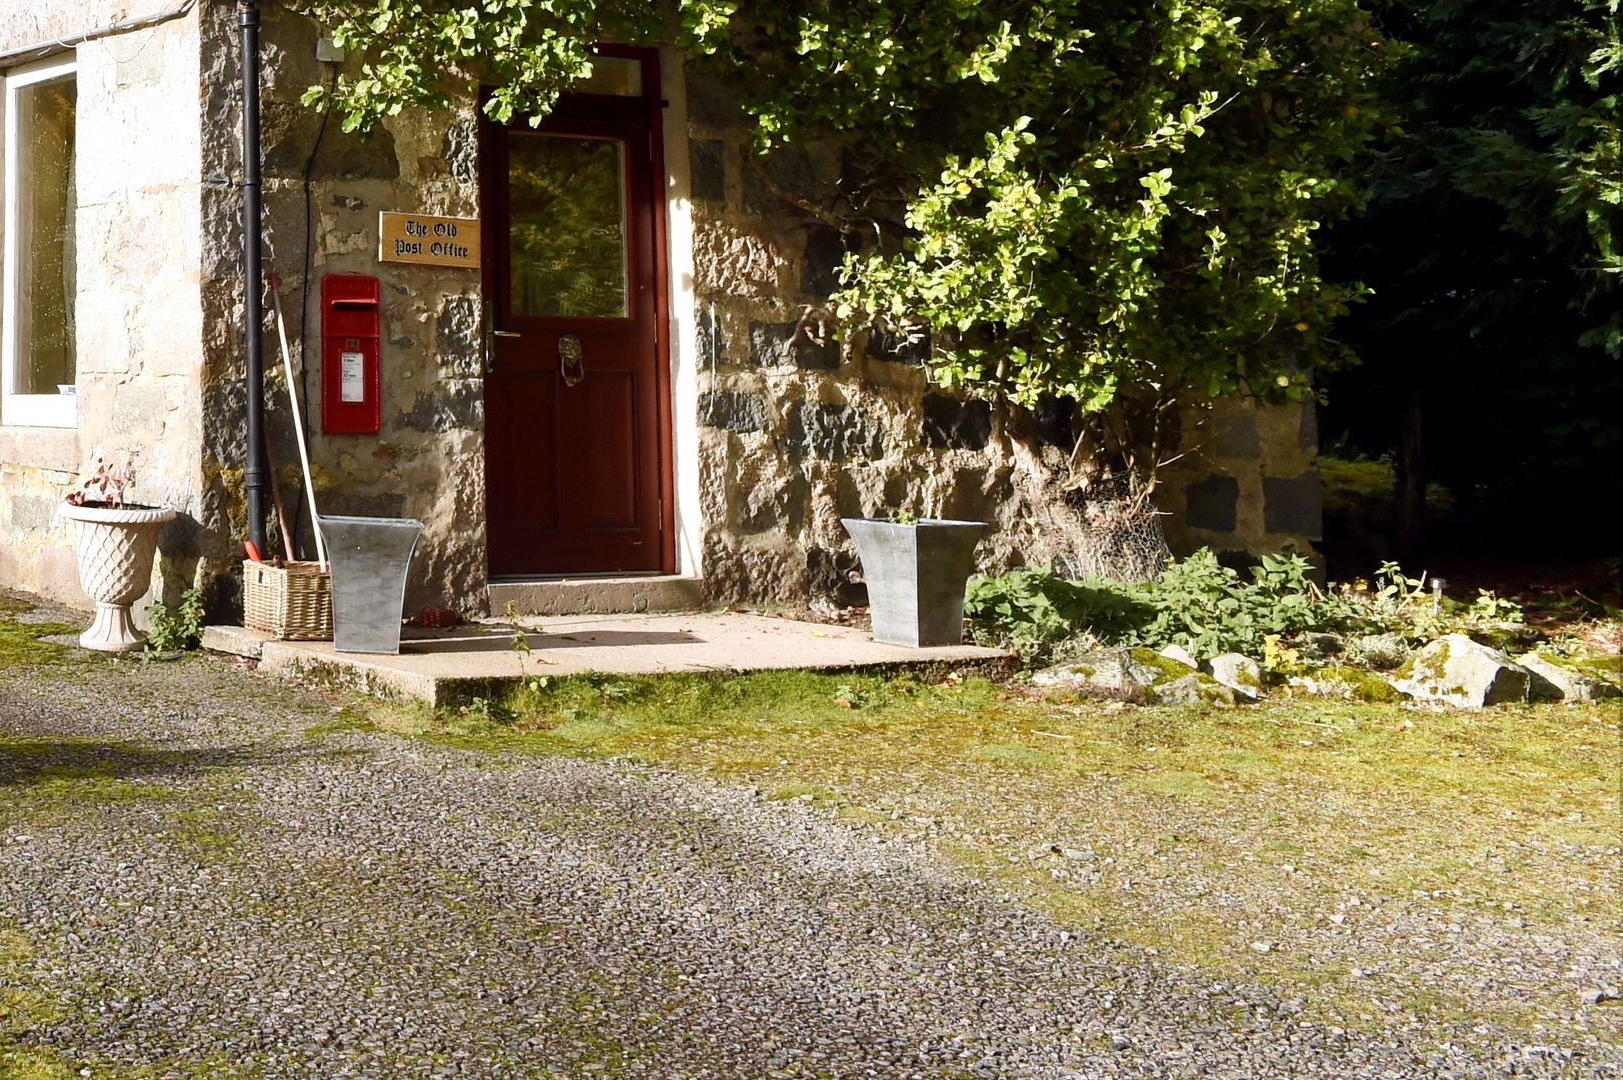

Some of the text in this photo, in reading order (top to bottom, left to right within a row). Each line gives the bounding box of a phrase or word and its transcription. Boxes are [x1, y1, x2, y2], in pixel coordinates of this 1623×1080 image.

[406, 221, 457, 237] The Old
[395, 239, 468, 257] Post Office
